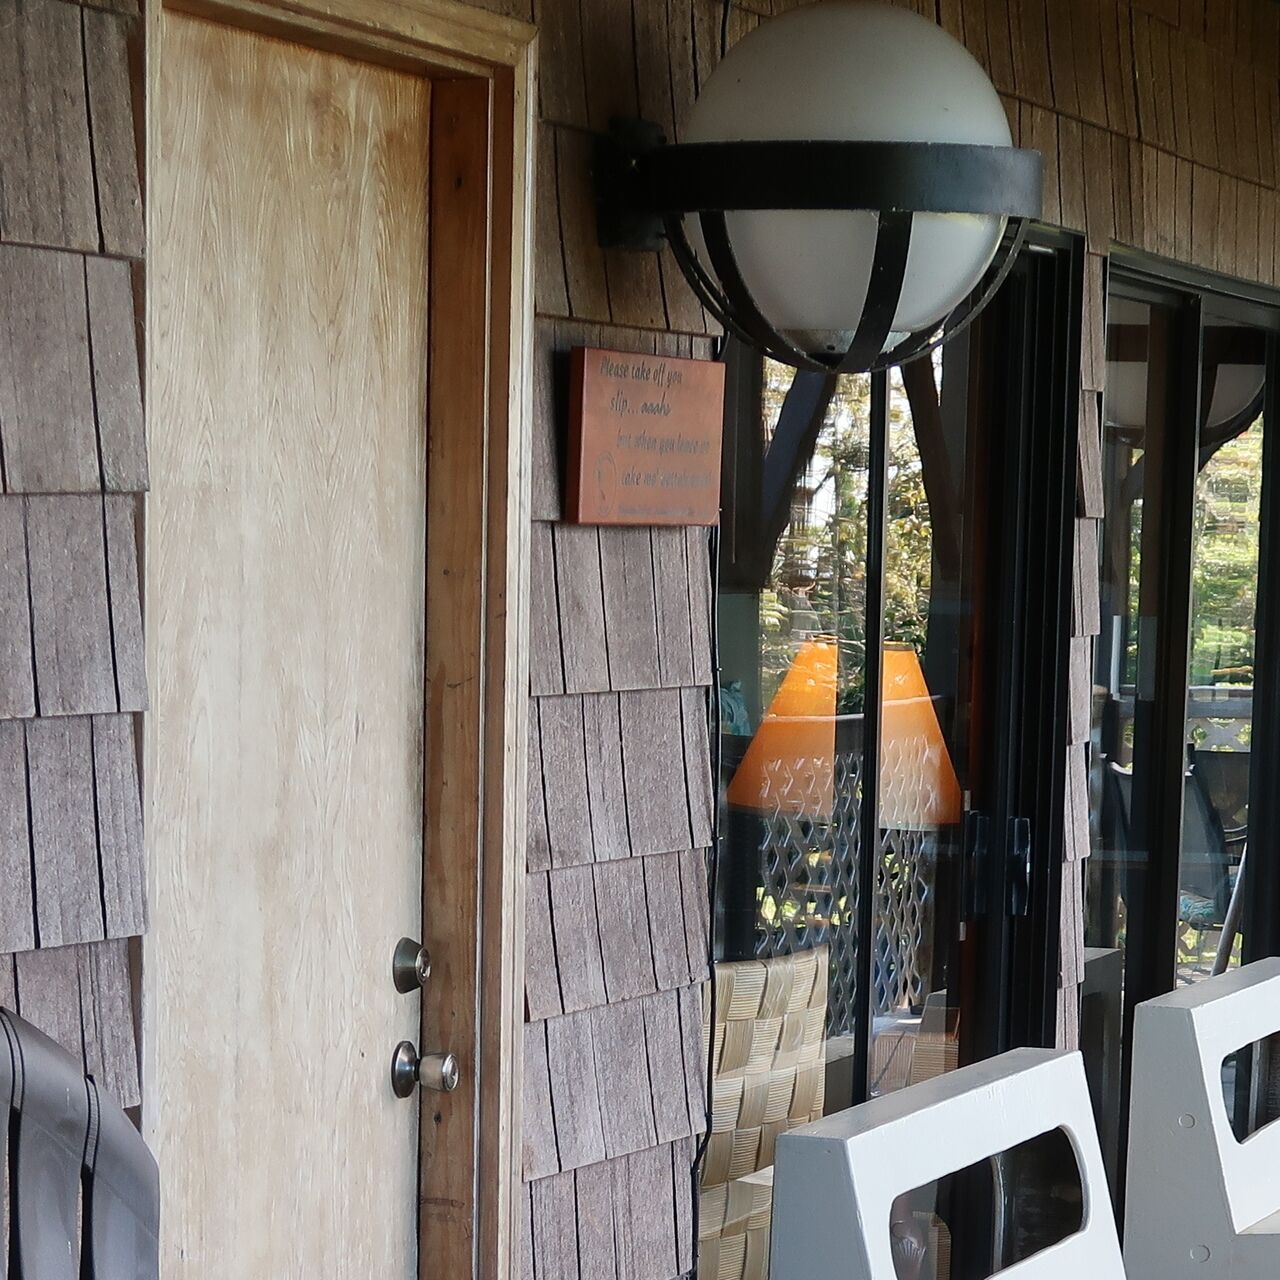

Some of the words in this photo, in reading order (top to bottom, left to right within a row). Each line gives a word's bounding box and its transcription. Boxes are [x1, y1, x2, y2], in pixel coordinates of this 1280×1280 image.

[600, 356, 629, 378] Please
[631, 359, 651, 382] take
[652, 361, 666, 388] off
[666, 370, 683, 388] you
